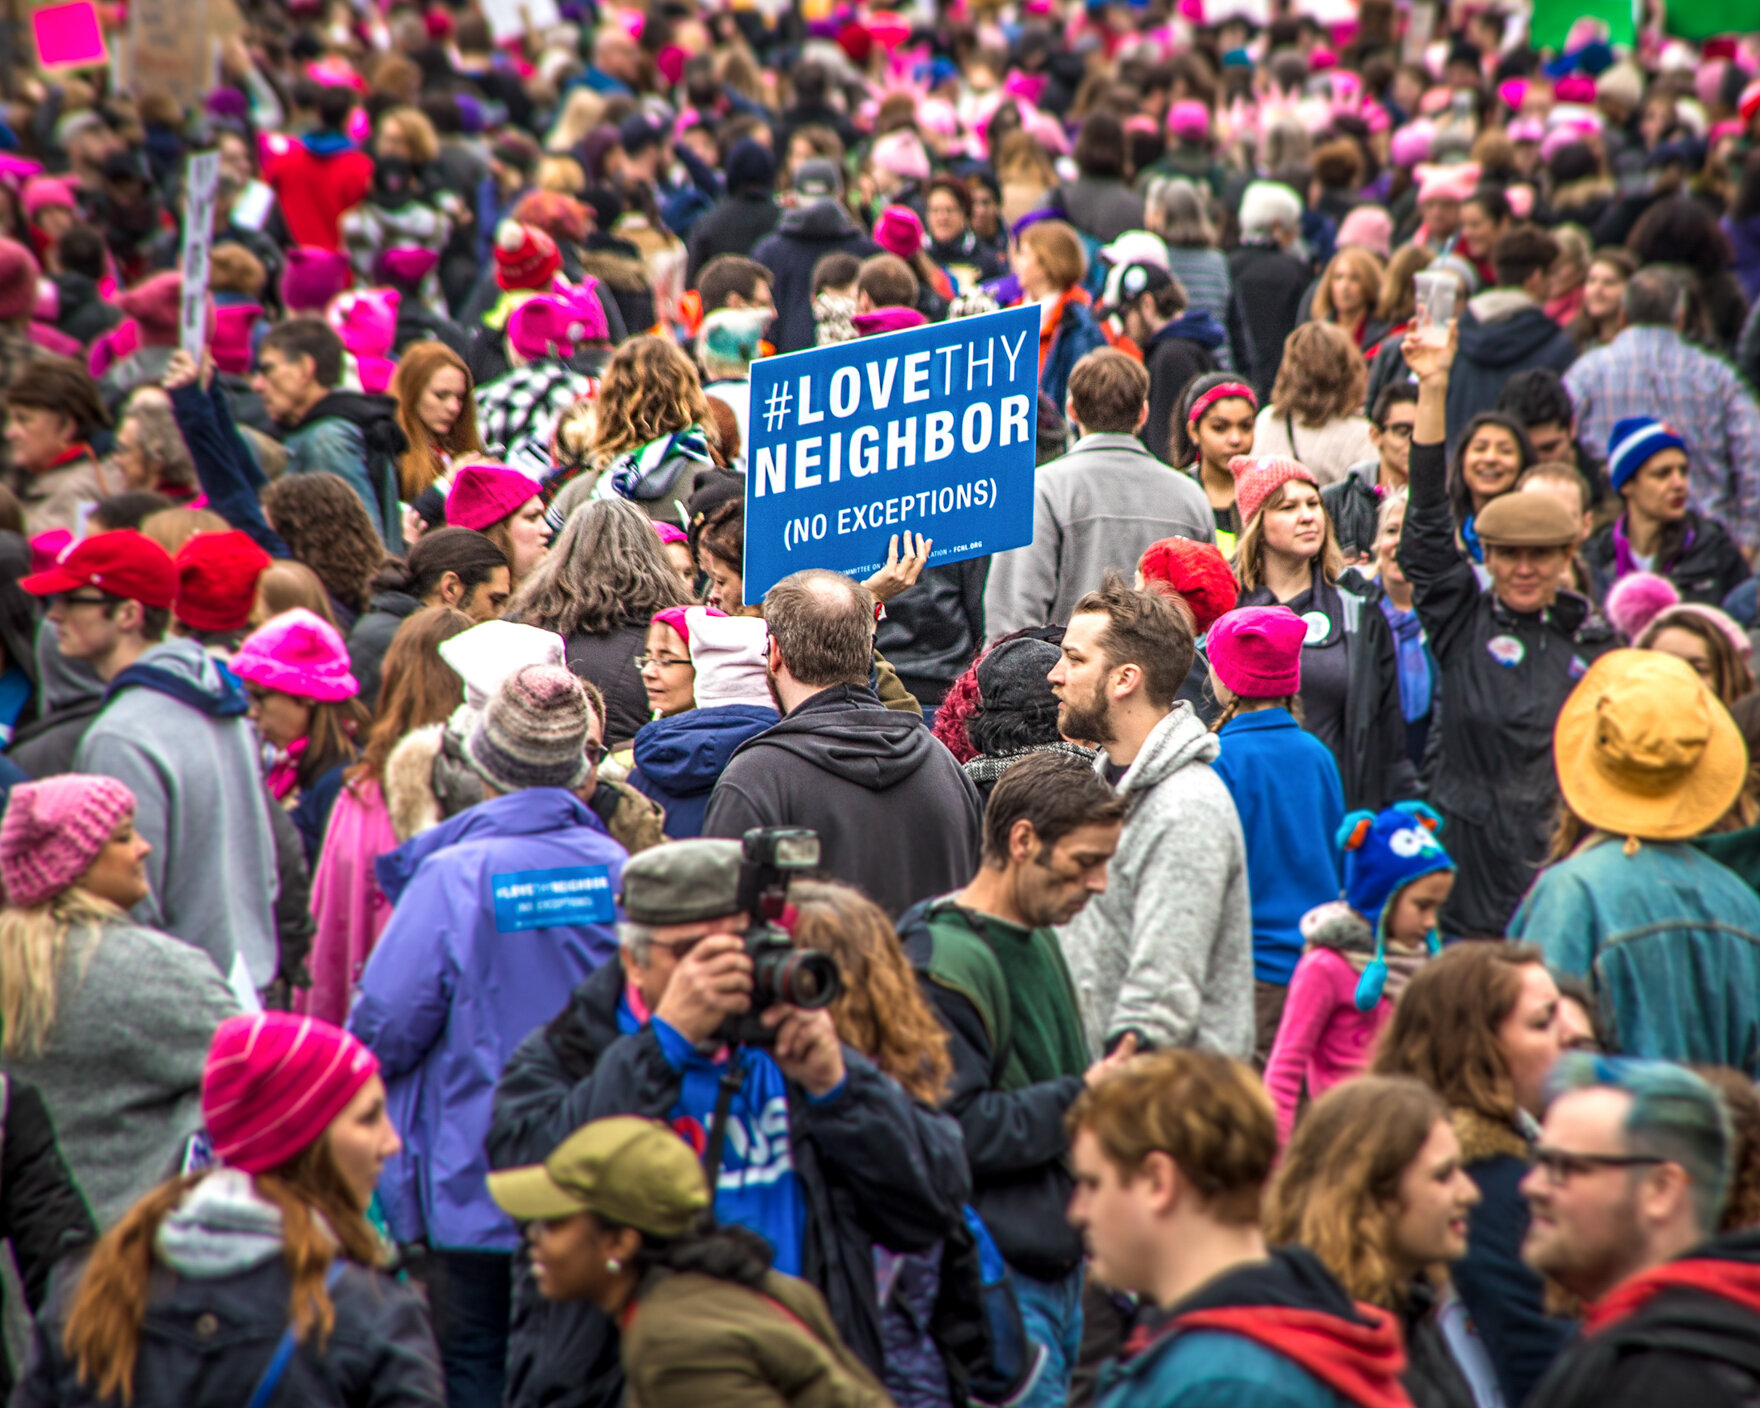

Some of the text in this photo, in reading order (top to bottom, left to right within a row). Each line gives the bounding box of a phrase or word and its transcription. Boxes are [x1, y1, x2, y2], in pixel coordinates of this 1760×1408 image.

[762, 330, 1028, 432] #LOVETHY
[755, 394, 1030, 498] NEIGHBOR
[783, 478, 997, 552] (NO EXCEPTIONS)
[839, 564, 871, 576] OMMITTEE
[872, 562, 880, 570] ON
[953, 541, 983, 553] FCNL.ORG
